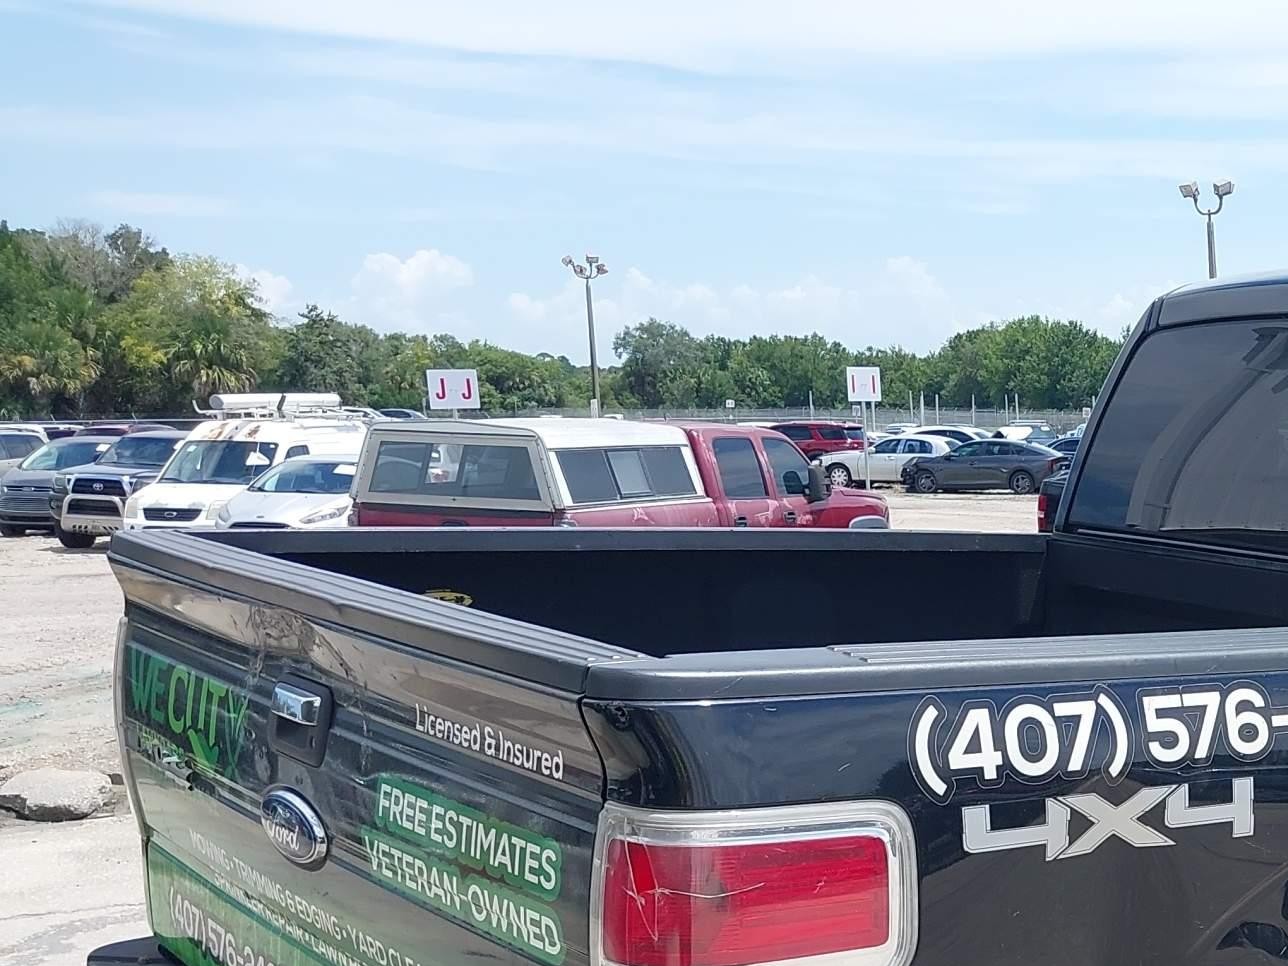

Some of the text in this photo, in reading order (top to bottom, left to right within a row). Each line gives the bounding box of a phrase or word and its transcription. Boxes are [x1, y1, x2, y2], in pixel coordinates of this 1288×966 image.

[415, 703, 564, 780] Licensed & Insured
[914, 692, 1129, 797] (407)
[266, 803, 300, 851] Ford
[378, 783, 558, 891] FREE ESTIMATES
[170, 886, 206, 952] (407)
[233, 856, 285, 908] TRIMMING
[285, 890, 296, 914] &
[295, 895, 341, 941] EDGING
[347, 924, 388, 966] YARD
[365, 835, 562, 956] VETERAN-OWNED
